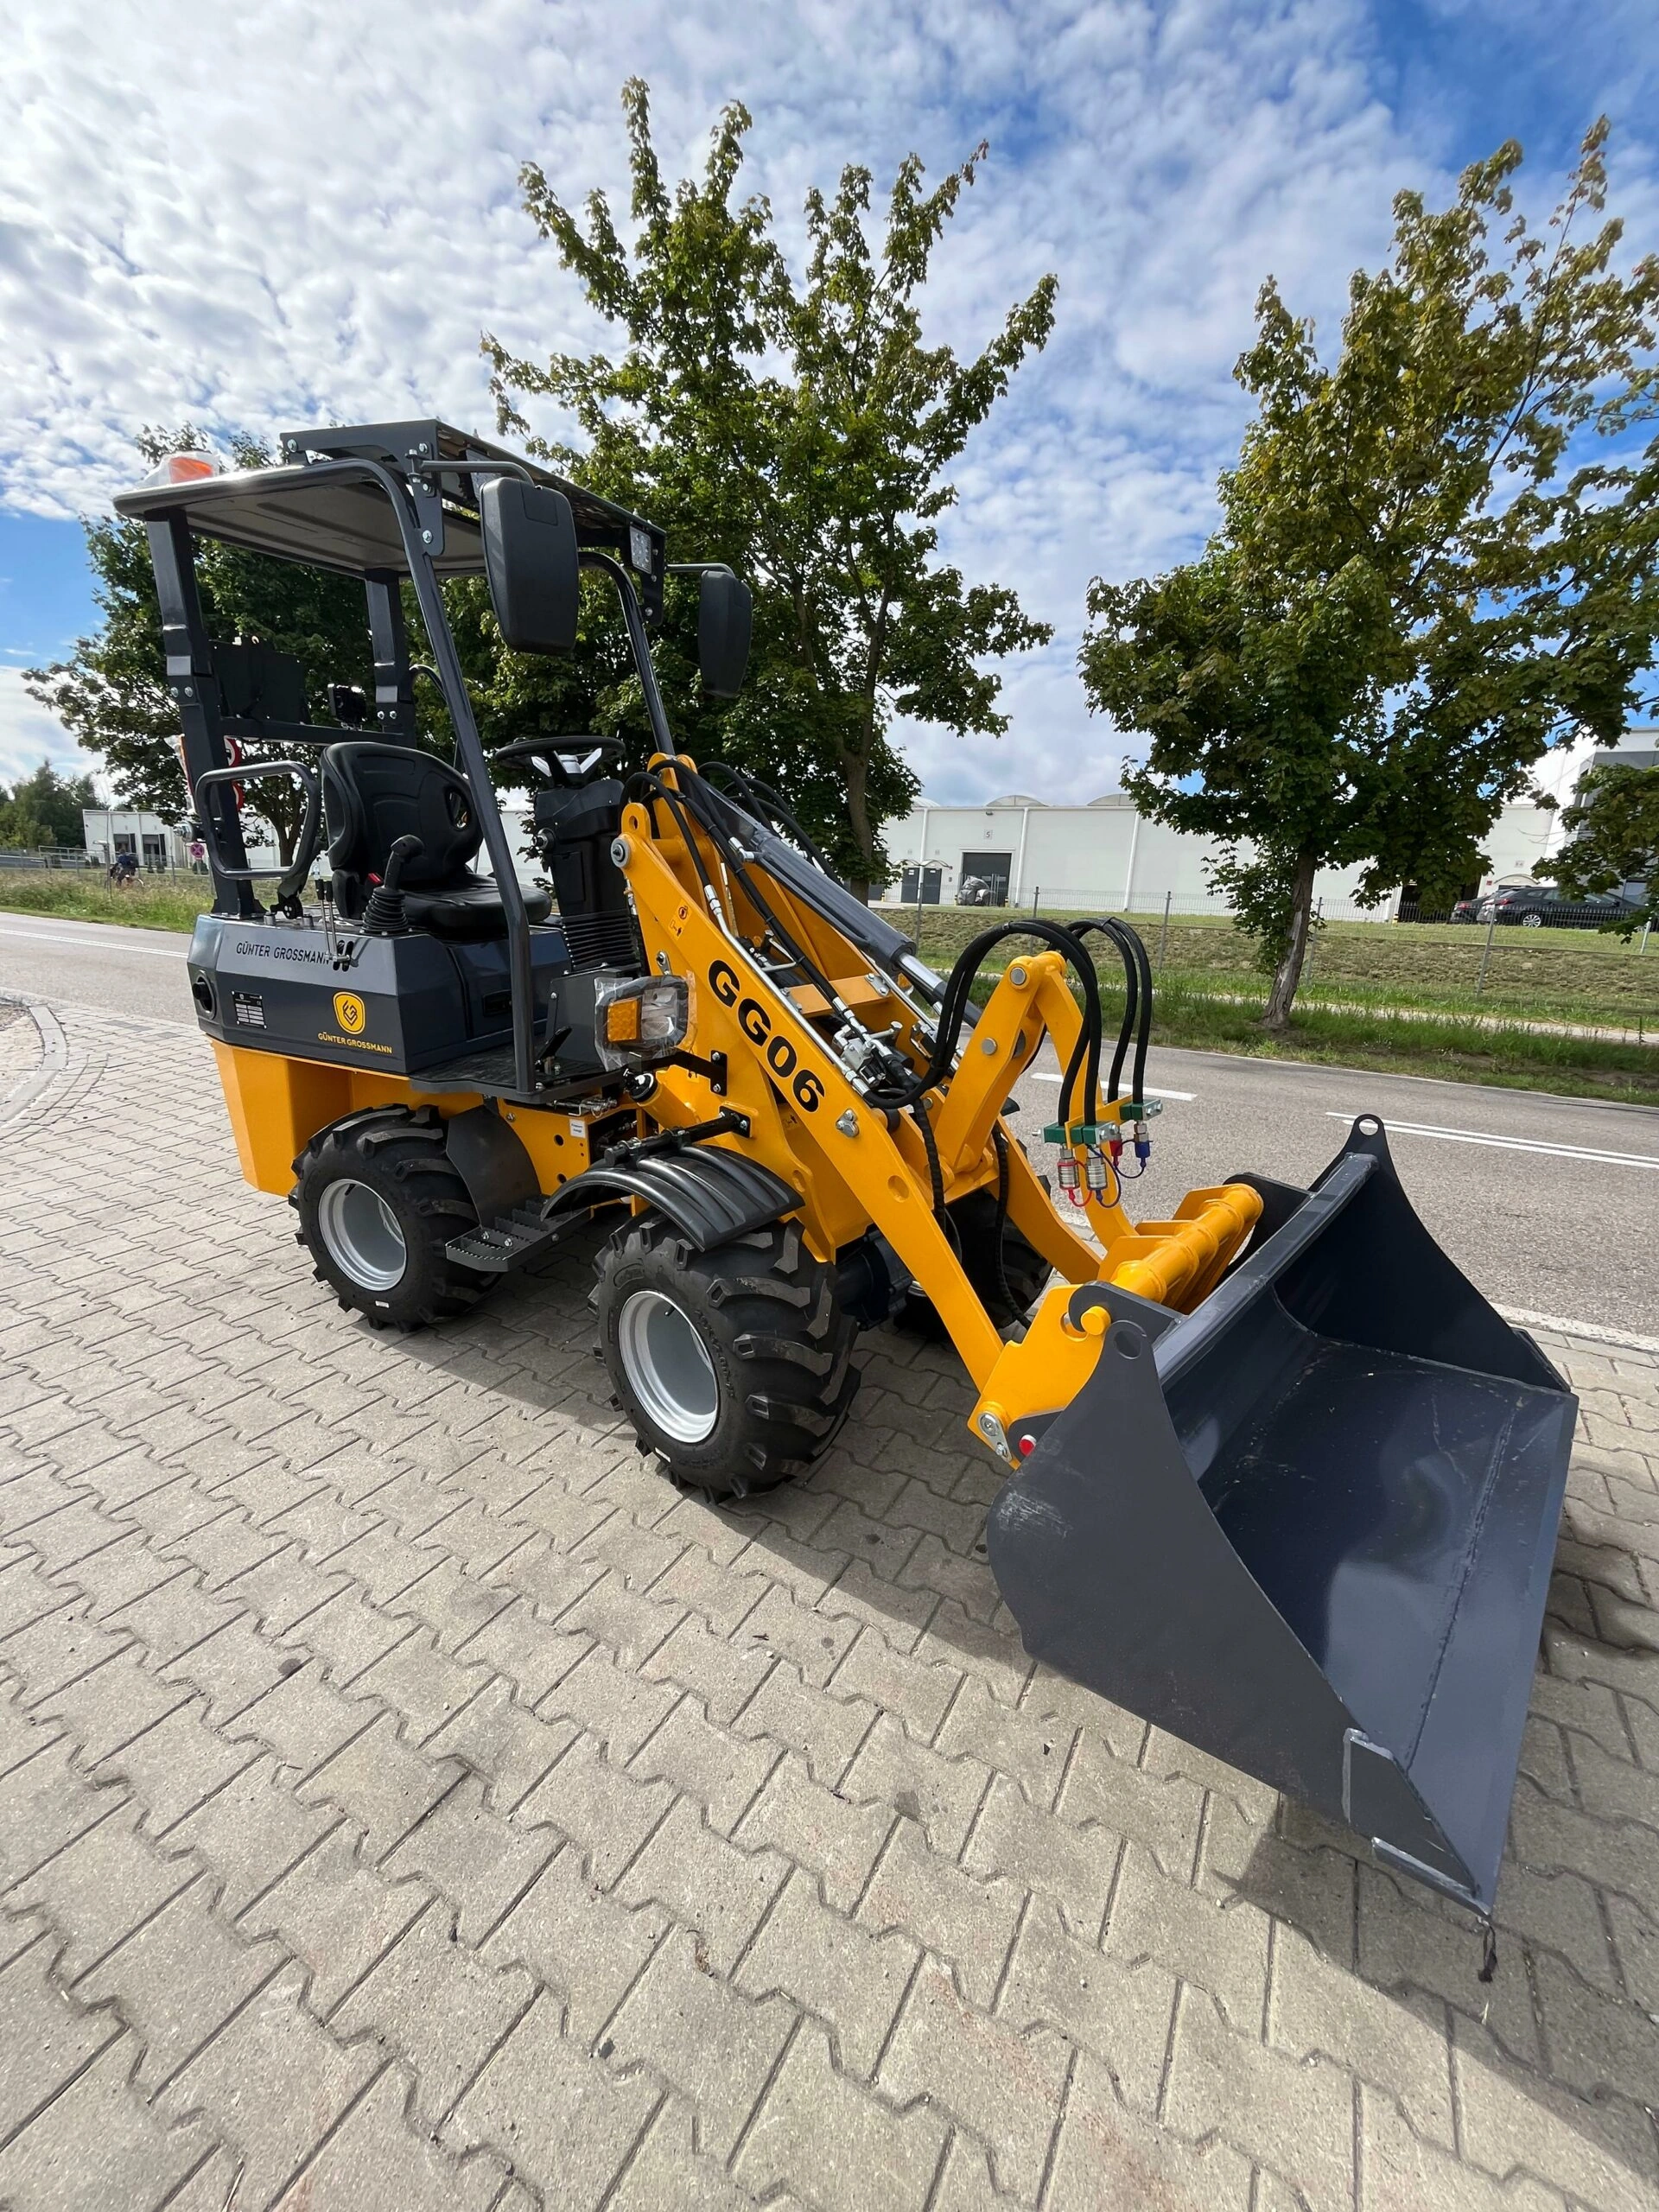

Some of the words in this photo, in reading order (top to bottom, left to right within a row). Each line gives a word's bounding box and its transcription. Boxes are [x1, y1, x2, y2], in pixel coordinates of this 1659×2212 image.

[236, 941, 270, 957] GÜNTER
[317, 1031, 346, 1045] GÜNTER
[346, 1039, 392, 1054] GROSSMANN
[708, 959, 825, 1113] GG06
